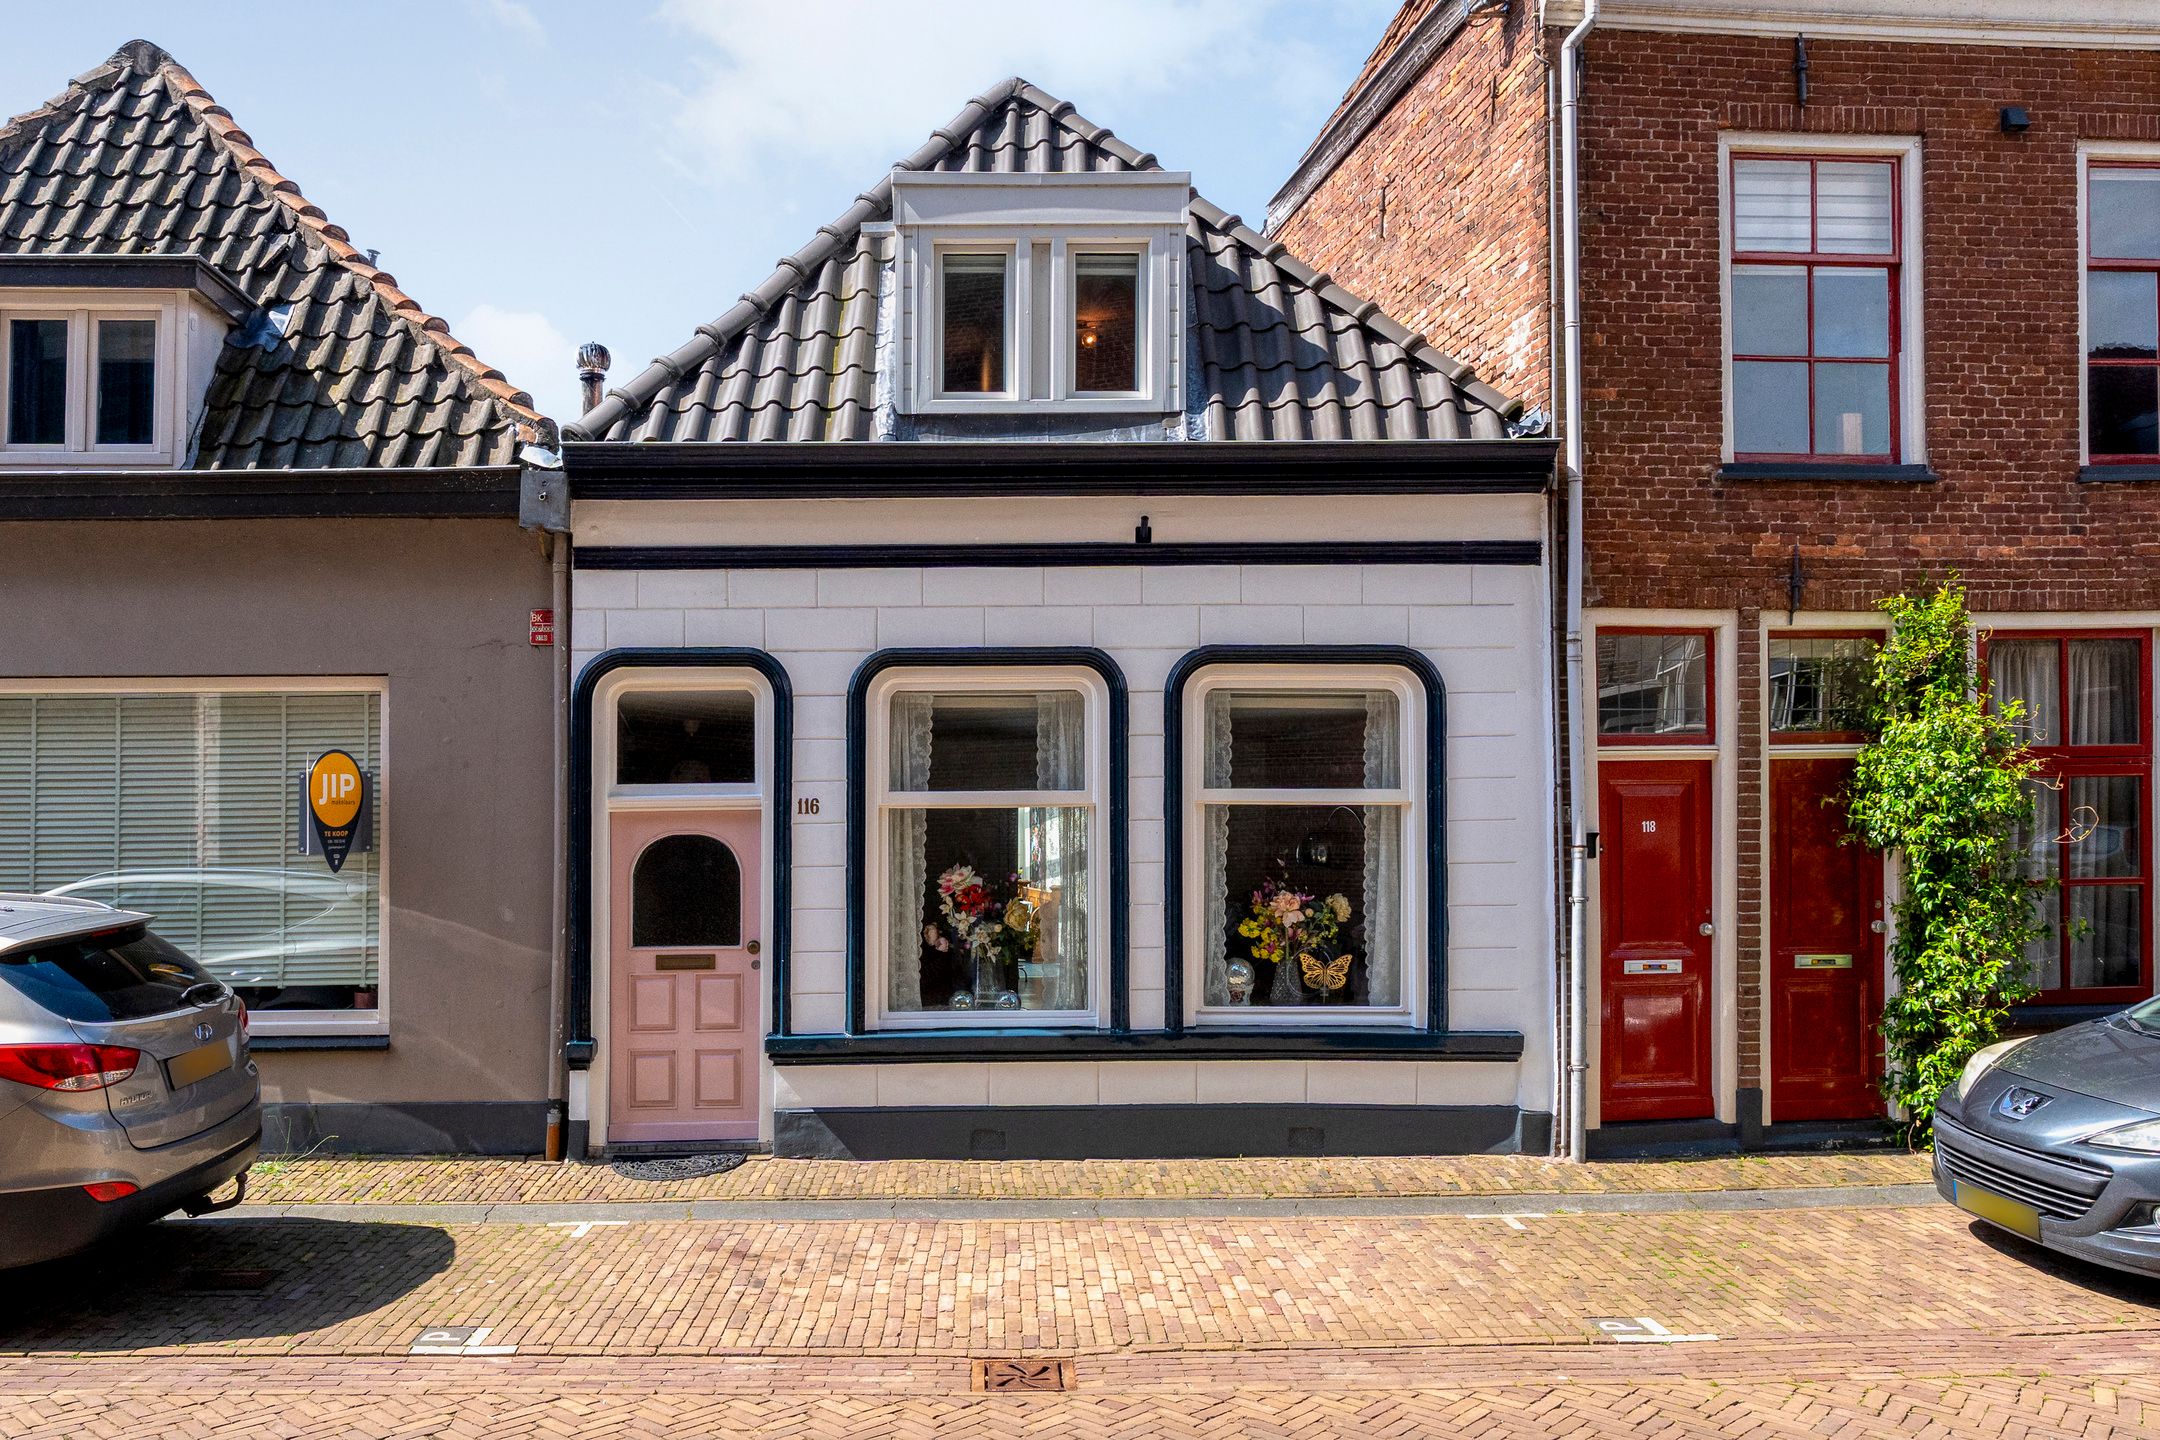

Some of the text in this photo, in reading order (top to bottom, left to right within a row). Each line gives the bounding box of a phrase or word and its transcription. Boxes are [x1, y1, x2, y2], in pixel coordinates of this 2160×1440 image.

[531, 614, 543, 622] BK
[318, 773, 355, 805] JIP
[798, 798, 820, 815] 116
[1641, 820, 1656, 833] 118
[1598, 1321, 1643, 1331] P
[419, 1331, 461, 1342] P
